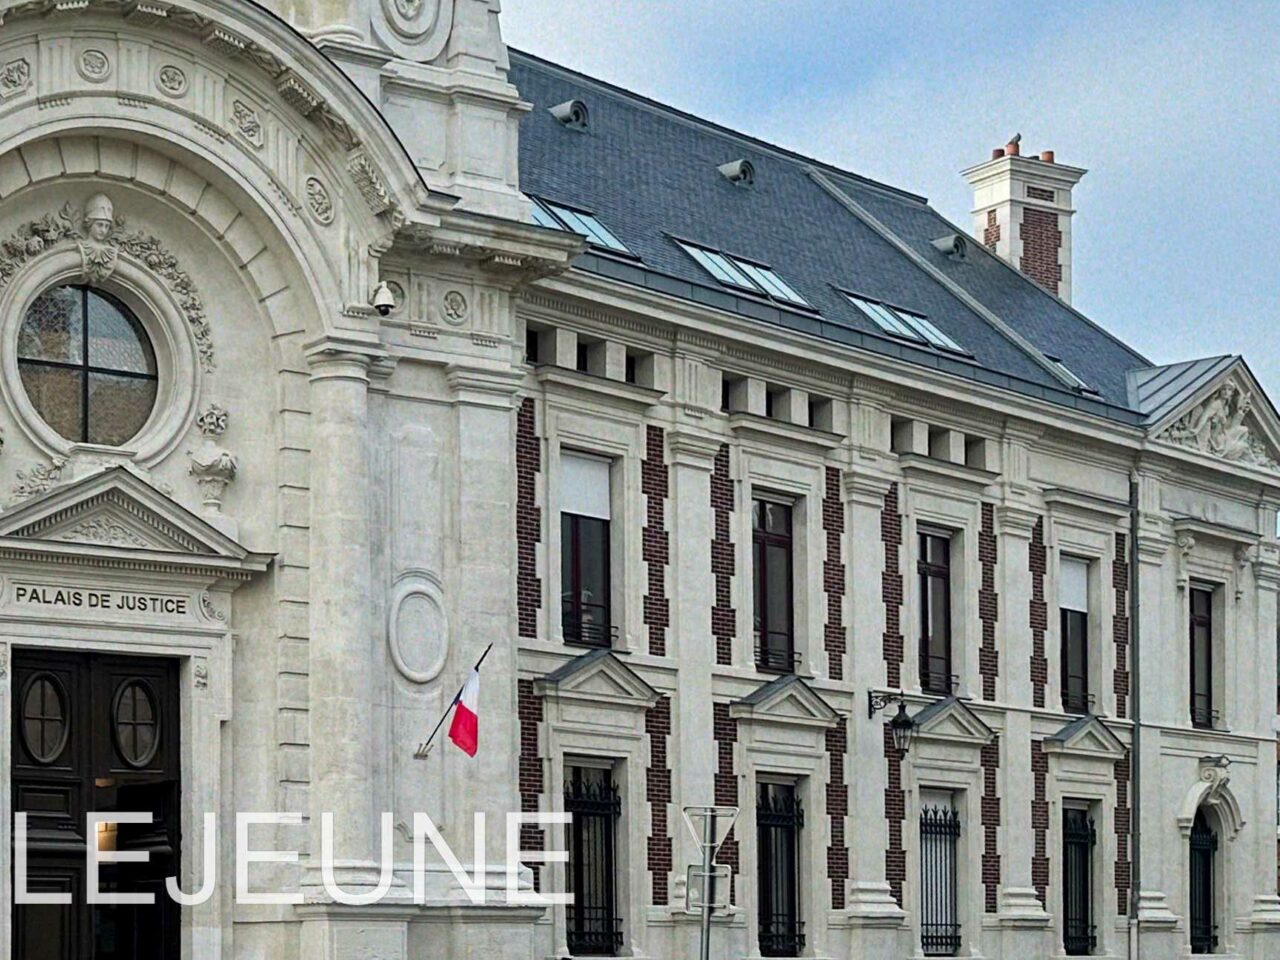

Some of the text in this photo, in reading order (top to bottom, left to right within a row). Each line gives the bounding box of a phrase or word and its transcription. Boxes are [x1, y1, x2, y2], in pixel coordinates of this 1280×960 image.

[16, 587, 186, 614] PALAIS DE JUSTICE
